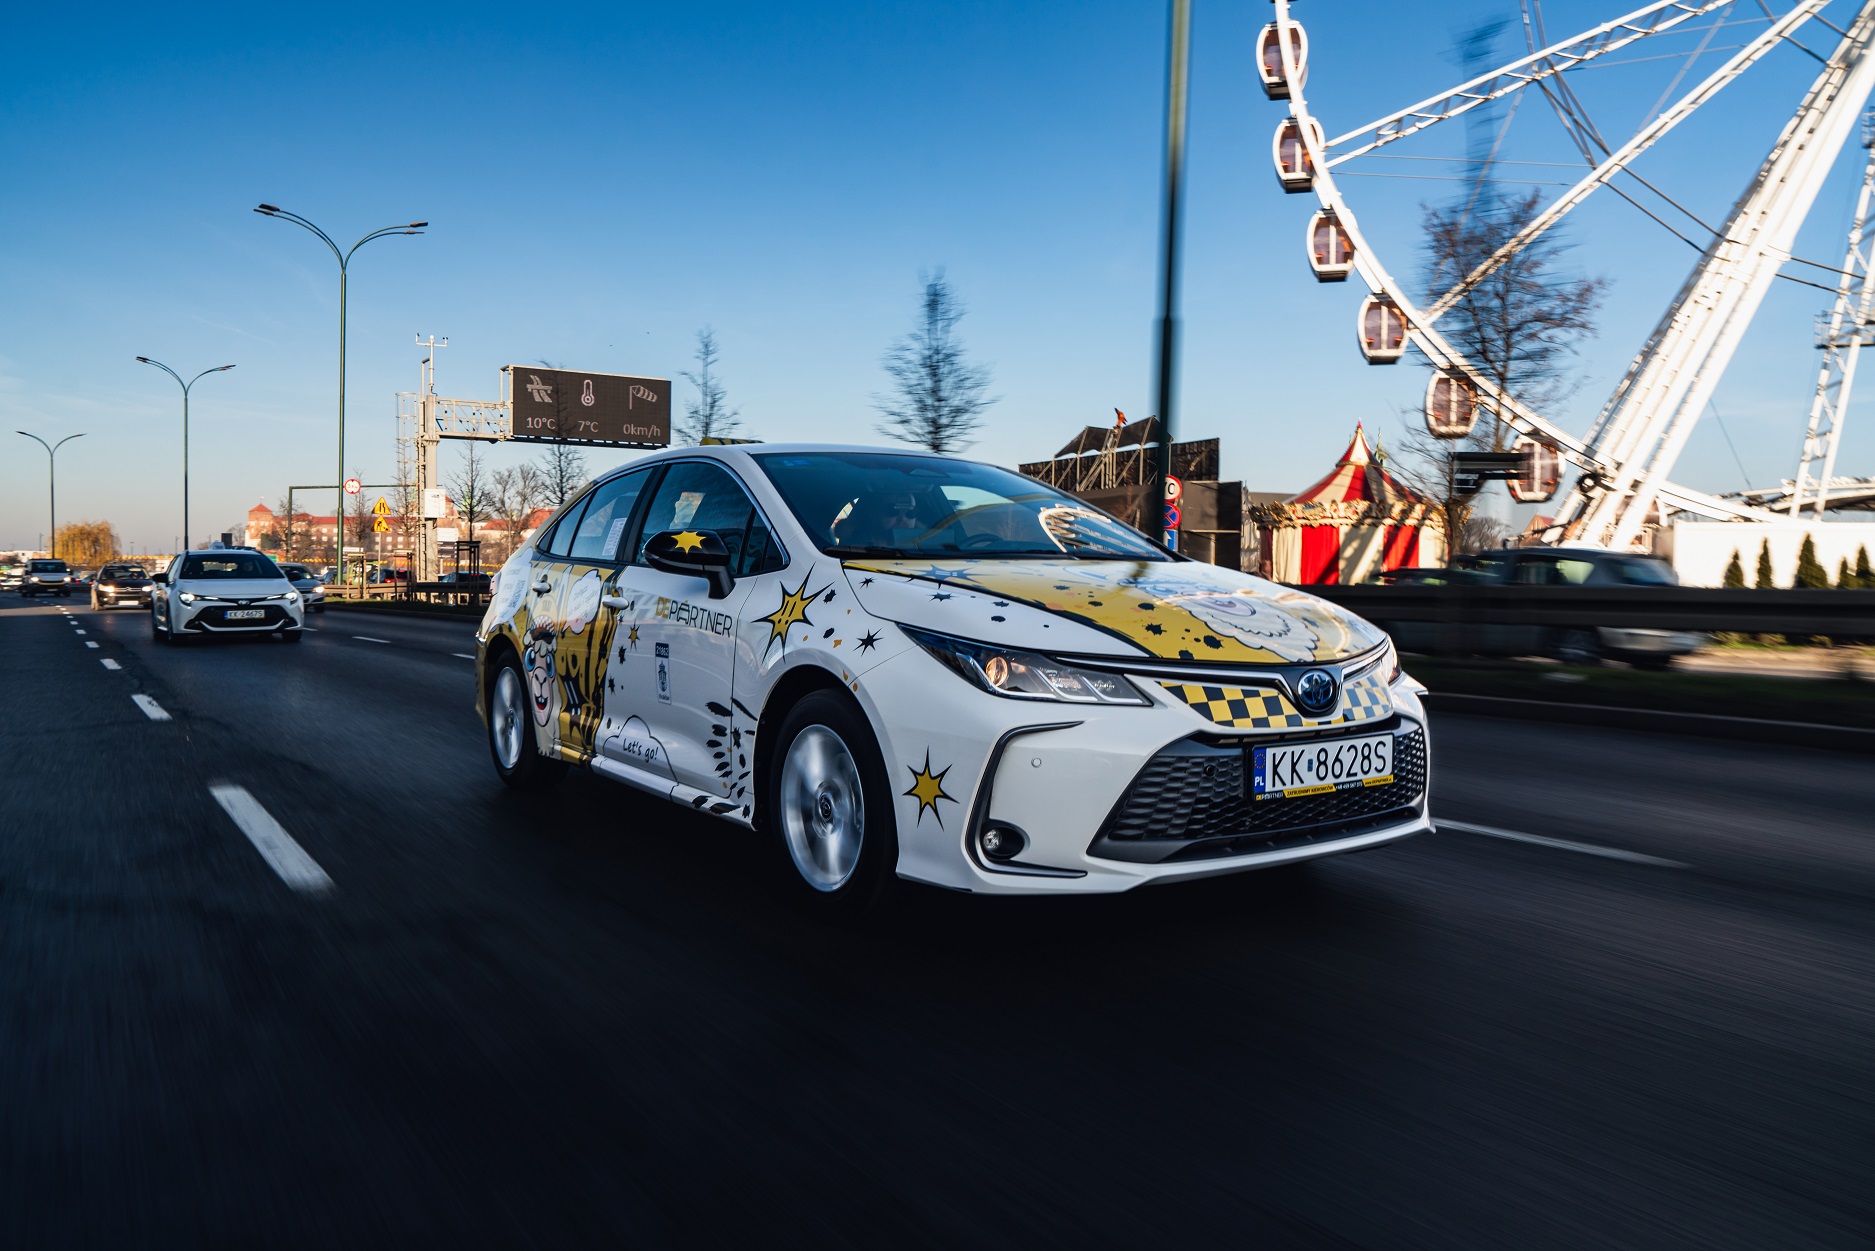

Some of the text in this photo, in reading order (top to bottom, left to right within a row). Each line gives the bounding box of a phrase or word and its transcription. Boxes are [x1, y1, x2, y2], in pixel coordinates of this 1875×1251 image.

[526, 417, 556, 430] 10°C
[578, 420, 599, 433] 7°C
[623, 423, 661, 438] 0km/h
[655, 596, 733, 638] DEPARTNER
[623, 738, 658, 763] Let's go!
[1272, 741, 1387, 788] KK 8628S
[1254, 776, 1264, 787] PL
